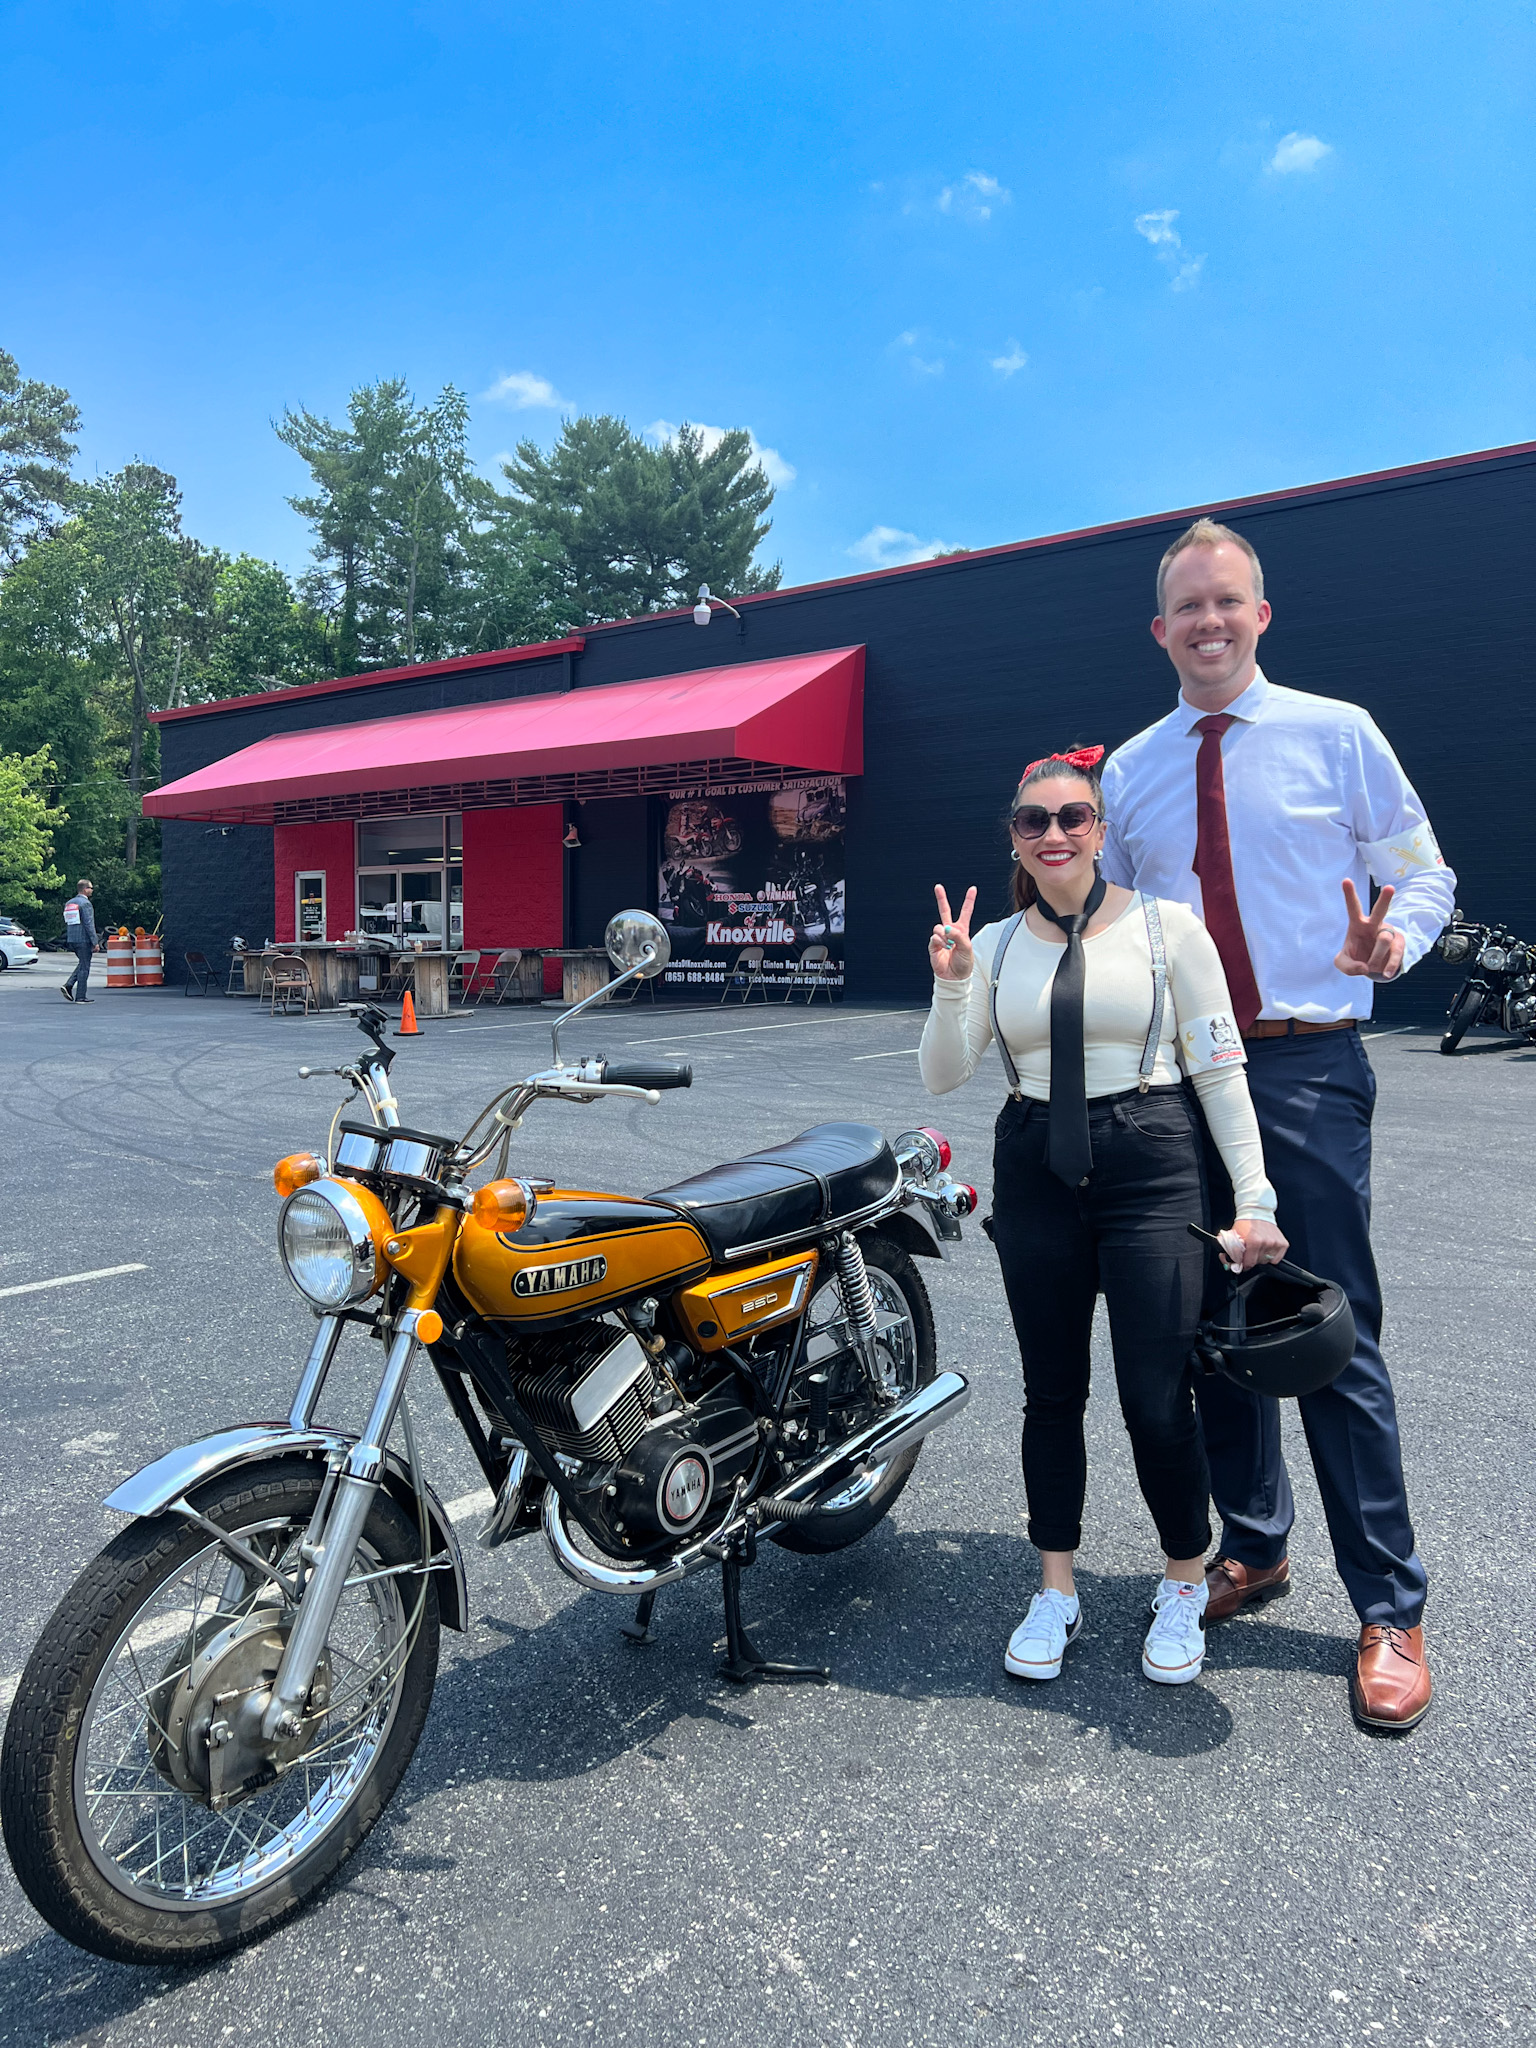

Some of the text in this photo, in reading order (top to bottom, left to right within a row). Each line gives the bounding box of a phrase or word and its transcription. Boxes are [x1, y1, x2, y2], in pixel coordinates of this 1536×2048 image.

[670, 790, 686, 799] OUR
[705, 787, 726, 797] GOAL
[728, 786, 737, 795] IS
[738, 783, 781, 794] CUSTOMER
[782, 777, 842, 790] SATISFACTION
[714, 891, 797, 901] HONDA YAMAHA
[738, 903, 774, 912] SUZUKI
[707, 920, 796, 944] Knoxville
[665, 972, 725, 983] (865) 688-8484
[526, 1259, 601, 1293] YAMAHA
[742, 1292, 778, 1313] 250
[670, 1477, 702, 1502] YAMAHA
